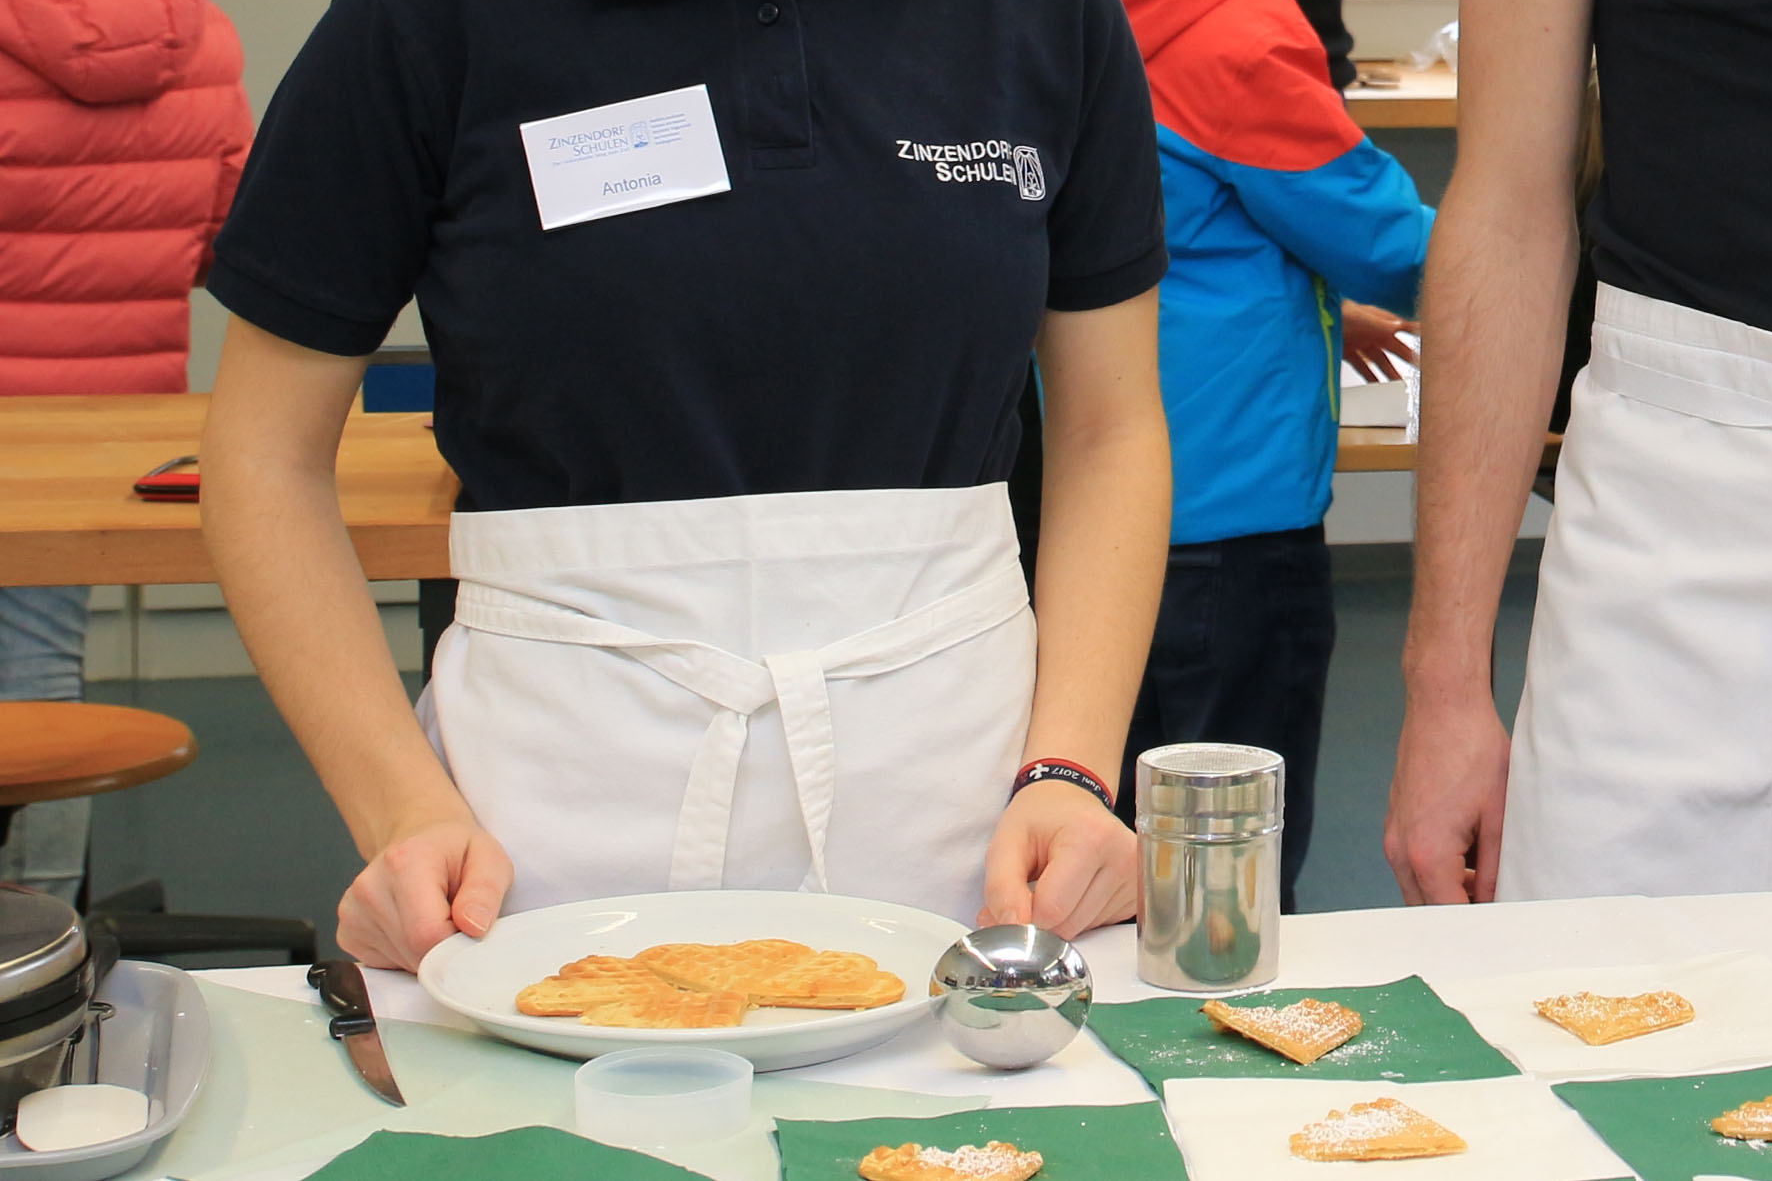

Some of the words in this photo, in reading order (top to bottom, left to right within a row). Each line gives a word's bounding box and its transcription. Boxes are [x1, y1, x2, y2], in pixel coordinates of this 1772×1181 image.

[549, 125, 626, 150] ZINZENDORF
[572, 137, 629, 157] SCHULEN
[602, 173, 662, 196] Antonia
[1051, 767, 1080, 780] 2017
[1081, 776, 1102, 791] Juni
